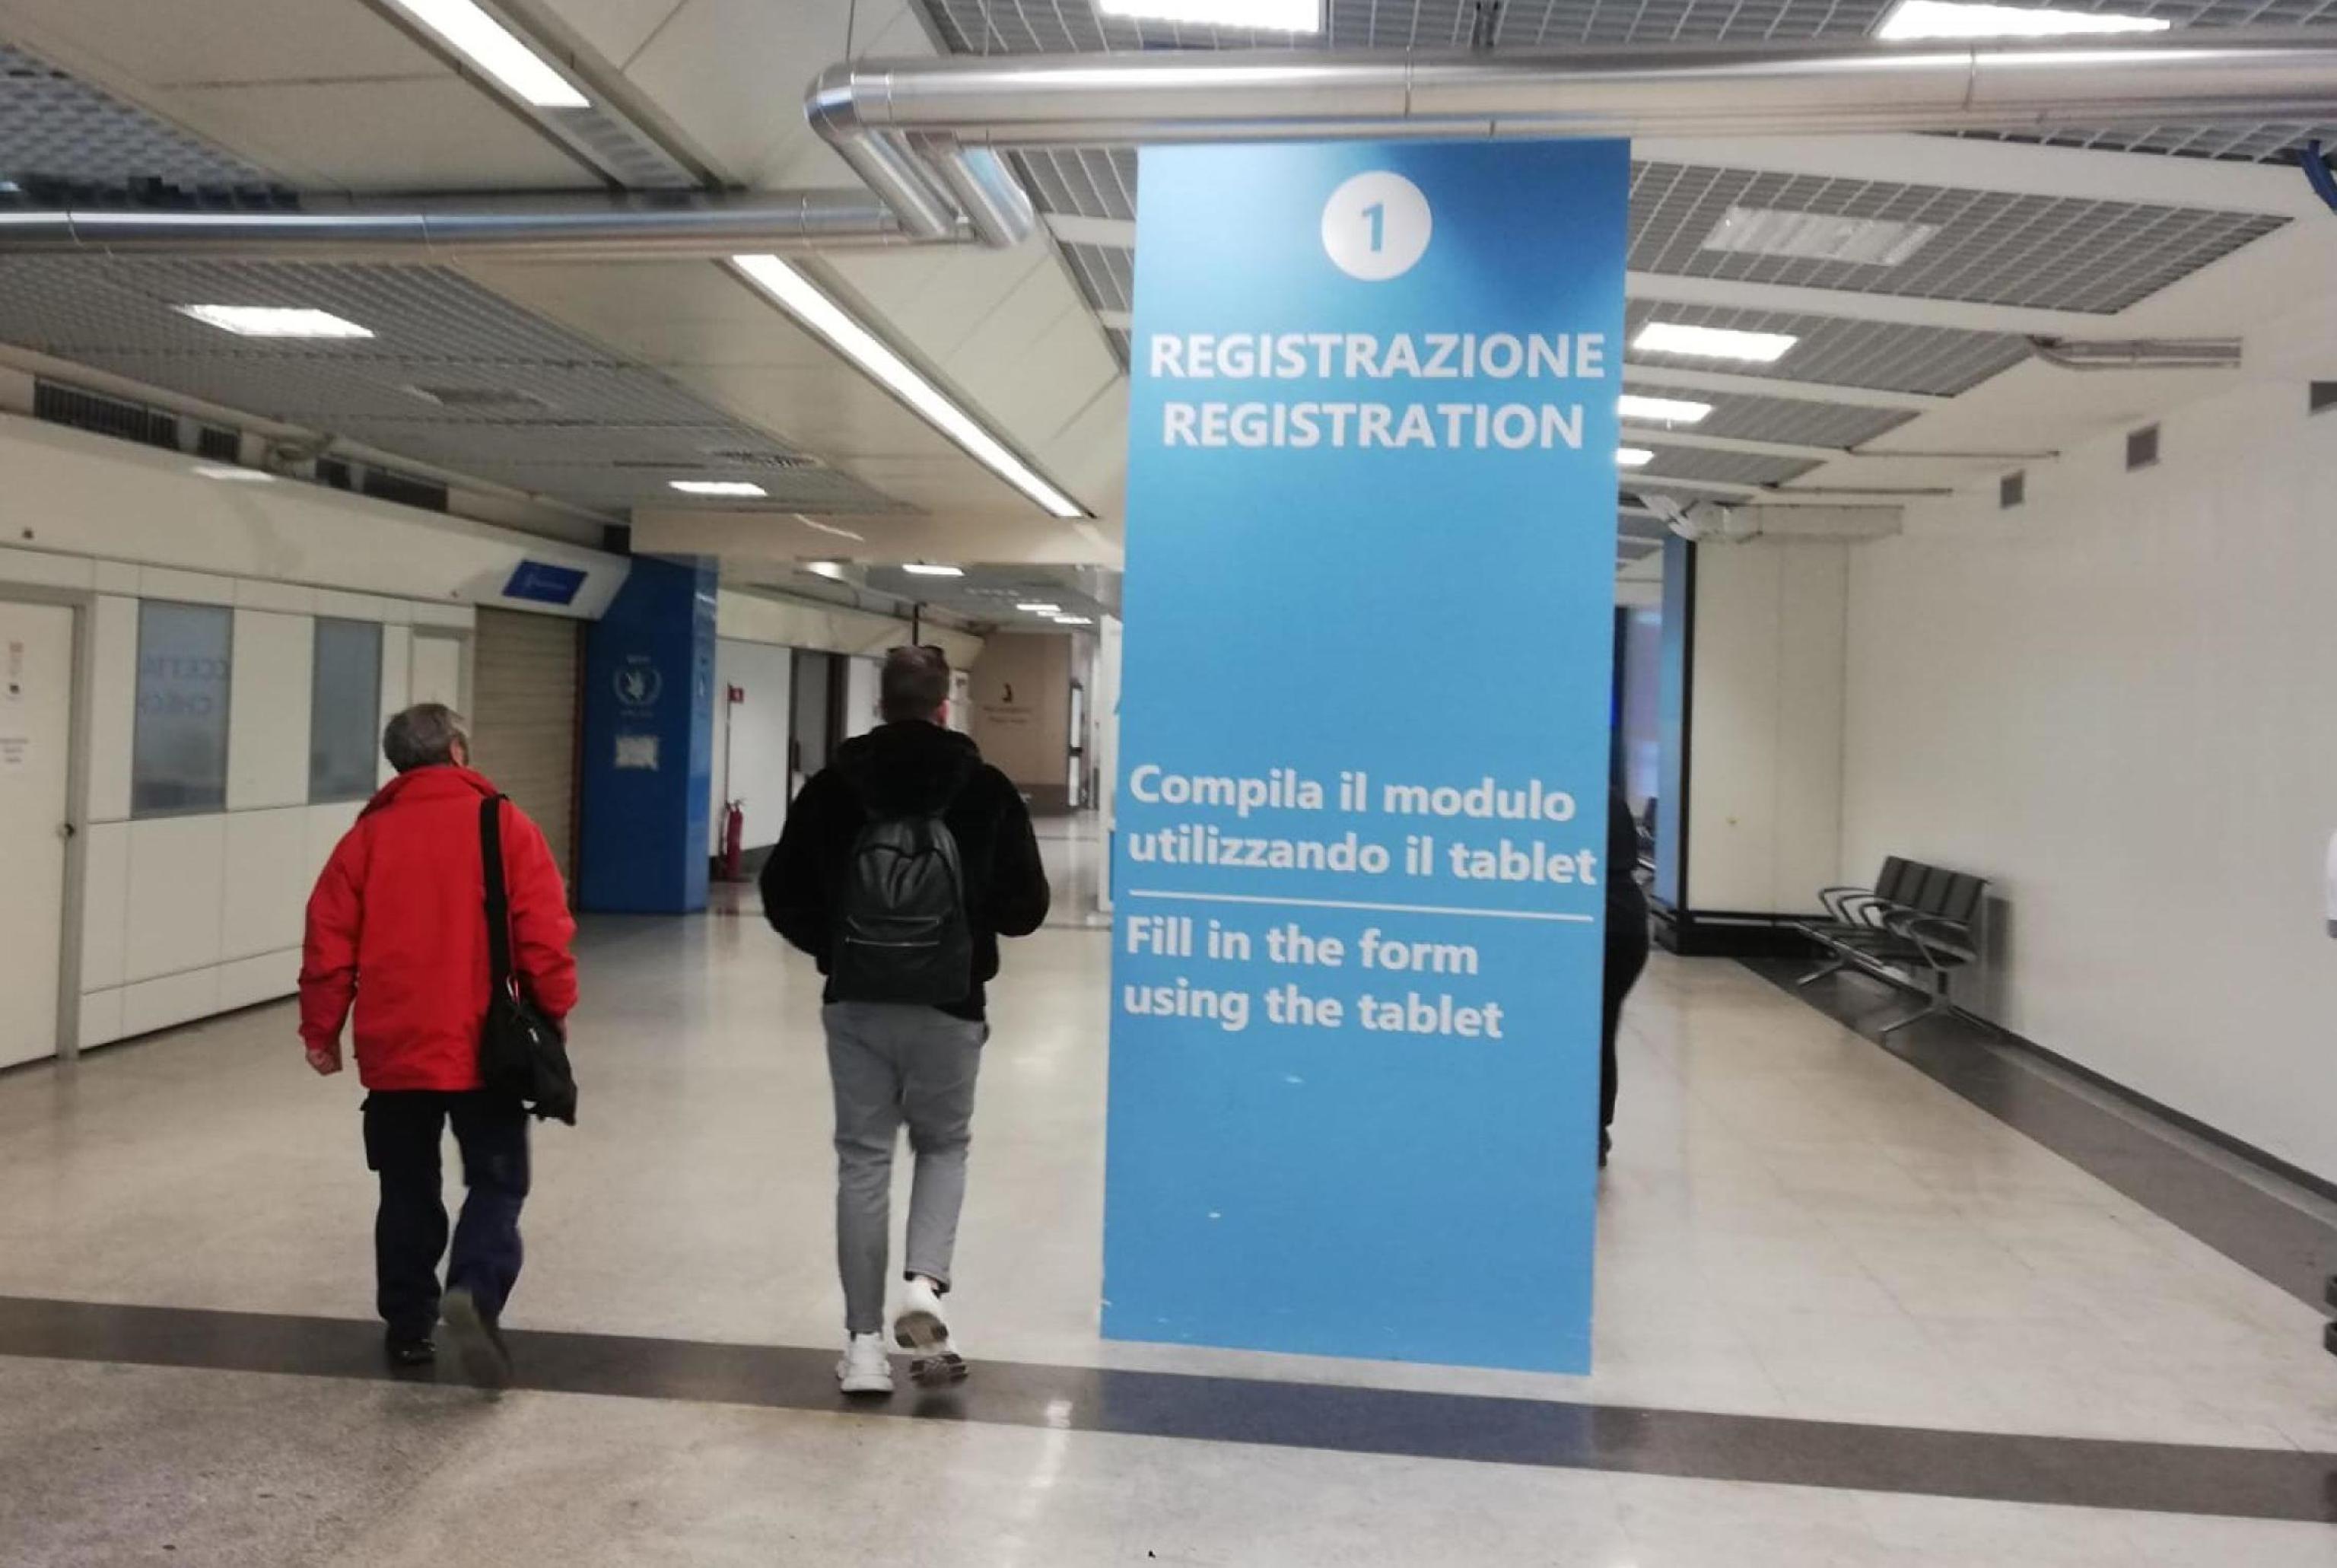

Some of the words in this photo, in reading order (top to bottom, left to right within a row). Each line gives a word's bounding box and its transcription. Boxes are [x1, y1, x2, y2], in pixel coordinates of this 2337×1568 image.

[1361, 203, 1385, 252] 1
[1150, 333, 1605, 379] REGISTRAZIONE
[1163, 402, 1584, 449] REGISTRATION
[1130, 765, 1323, 816] Compila
[1340, 771, 1366, 812] il
[1384, 778, 1575, 822] modulo
[1129, 825, 1389, 873] utilizzando
[1406, 835, 1432, 875] il
[1448, 840, 1597, 885] tablet
[1127, 916, 1191, 956] Fill
[1208, 920, 1250, 960] in
[1265, 924, 1344, 966] the
[1358, 928, 1477, 974] form
[1124, 978, 1249, 1031] using
[1264, 984, 1343, 1027] the
[1357, 992, 1502, 1038] tablet
